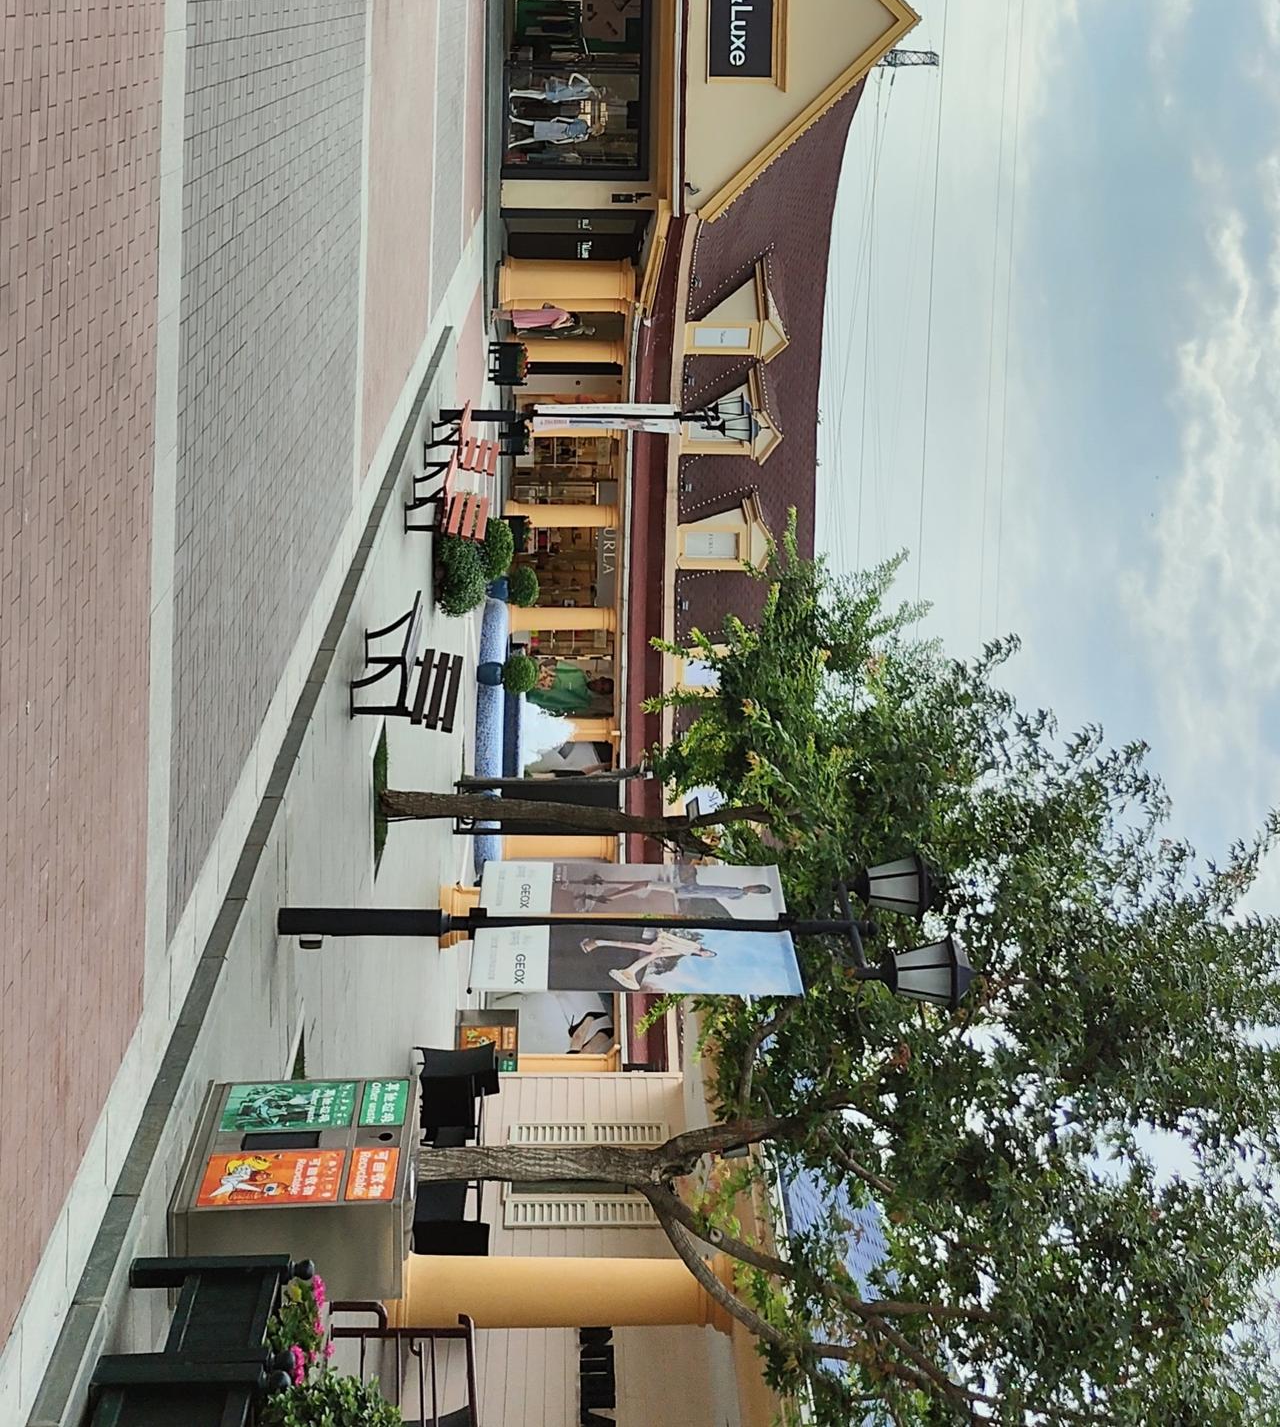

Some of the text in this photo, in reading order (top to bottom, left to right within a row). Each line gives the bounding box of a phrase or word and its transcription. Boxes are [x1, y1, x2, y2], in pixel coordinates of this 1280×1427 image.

[603, 527, 616, 574] URLA
[519, 884, 531, 909] GEOX
[514, 953, 526, 985] GEOX
[365, 1082, 382, 1124] Other waste
[380, 1082, 400, 1124] 其他垃圾
[288, 1158, 307, 1196] Recyclable
[302, 1158, 321, 1196] 可回收物
[353, 1152, 371, 1197] Recyclable
[368, 1151, 389, 1197] 可回收物
